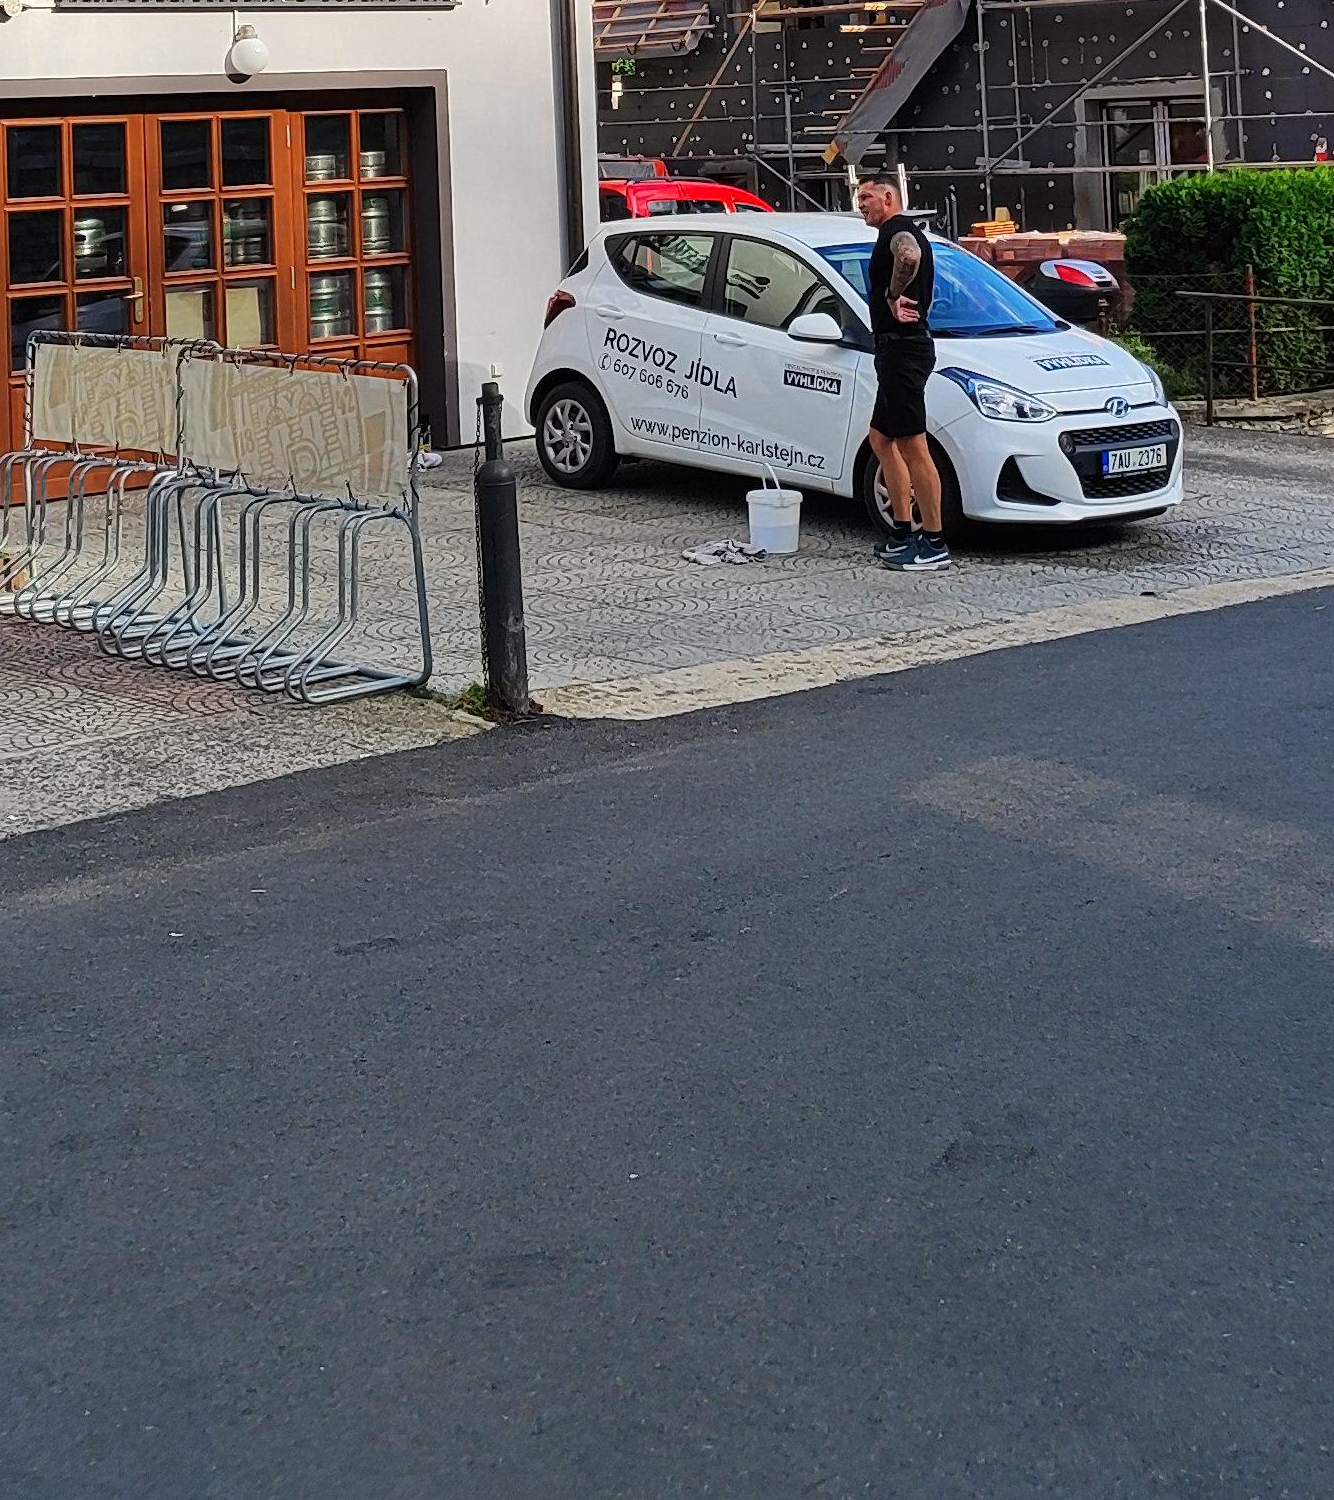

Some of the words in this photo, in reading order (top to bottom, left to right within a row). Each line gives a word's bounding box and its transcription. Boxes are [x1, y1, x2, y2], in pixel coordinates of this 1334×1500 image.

[603, 327, 678, 374] ROZVOZ
[684, 357, 738, 399] JÍDLA
[613, 358, 636, 381] 607
[639, 368, 663, 389] 606
[666, 379, 689, 399] 676
[630, 415, 825, 470] www.penzion-karlstejn.cz
[1111, 451, 1131, 471] 7AU
[1137, 447, 1162, 467] 2376
